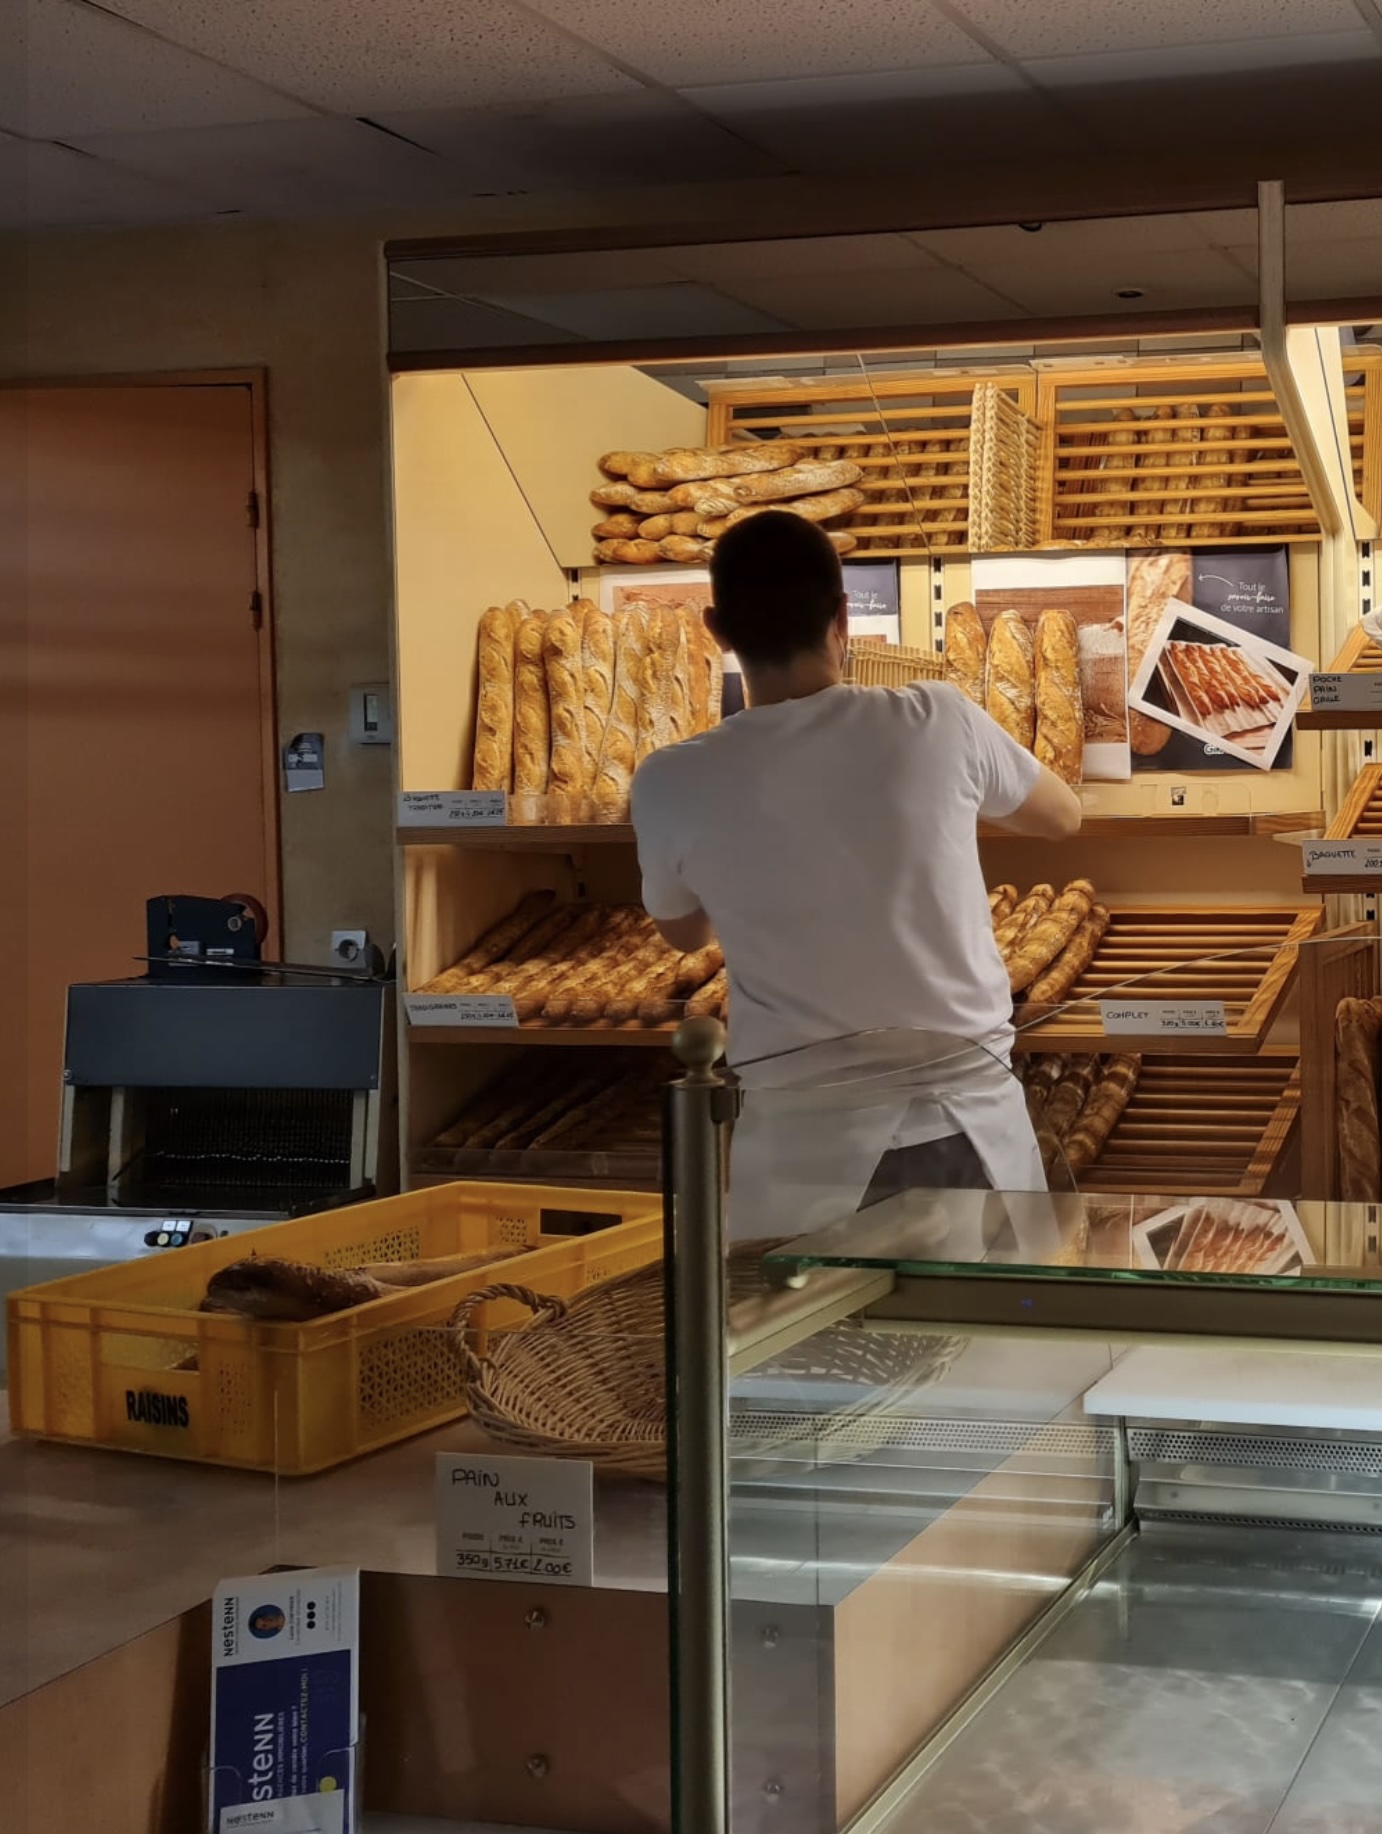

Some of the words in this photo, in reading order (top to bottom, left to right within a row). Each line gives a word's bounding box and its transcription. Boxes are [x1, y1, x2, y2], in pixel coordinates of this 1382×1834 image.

[1239, 582, 1256, 591] Tout
[1258, 582, 1266, 590] le
[1220, 604, 1231, 612] de
[1233, 605, 1254, 613] votre
[1257, 606, 1284, 614] artisan
[1309, 850, 1355, 860] BAGUETTE
[1106, 1011, 1149, 1020] COMPLET
[126, 1389, 189, 1427] RAISINS
[452, 1469, 499, 1487] PAIN
[494, 1491, 528, 1506] AUX
